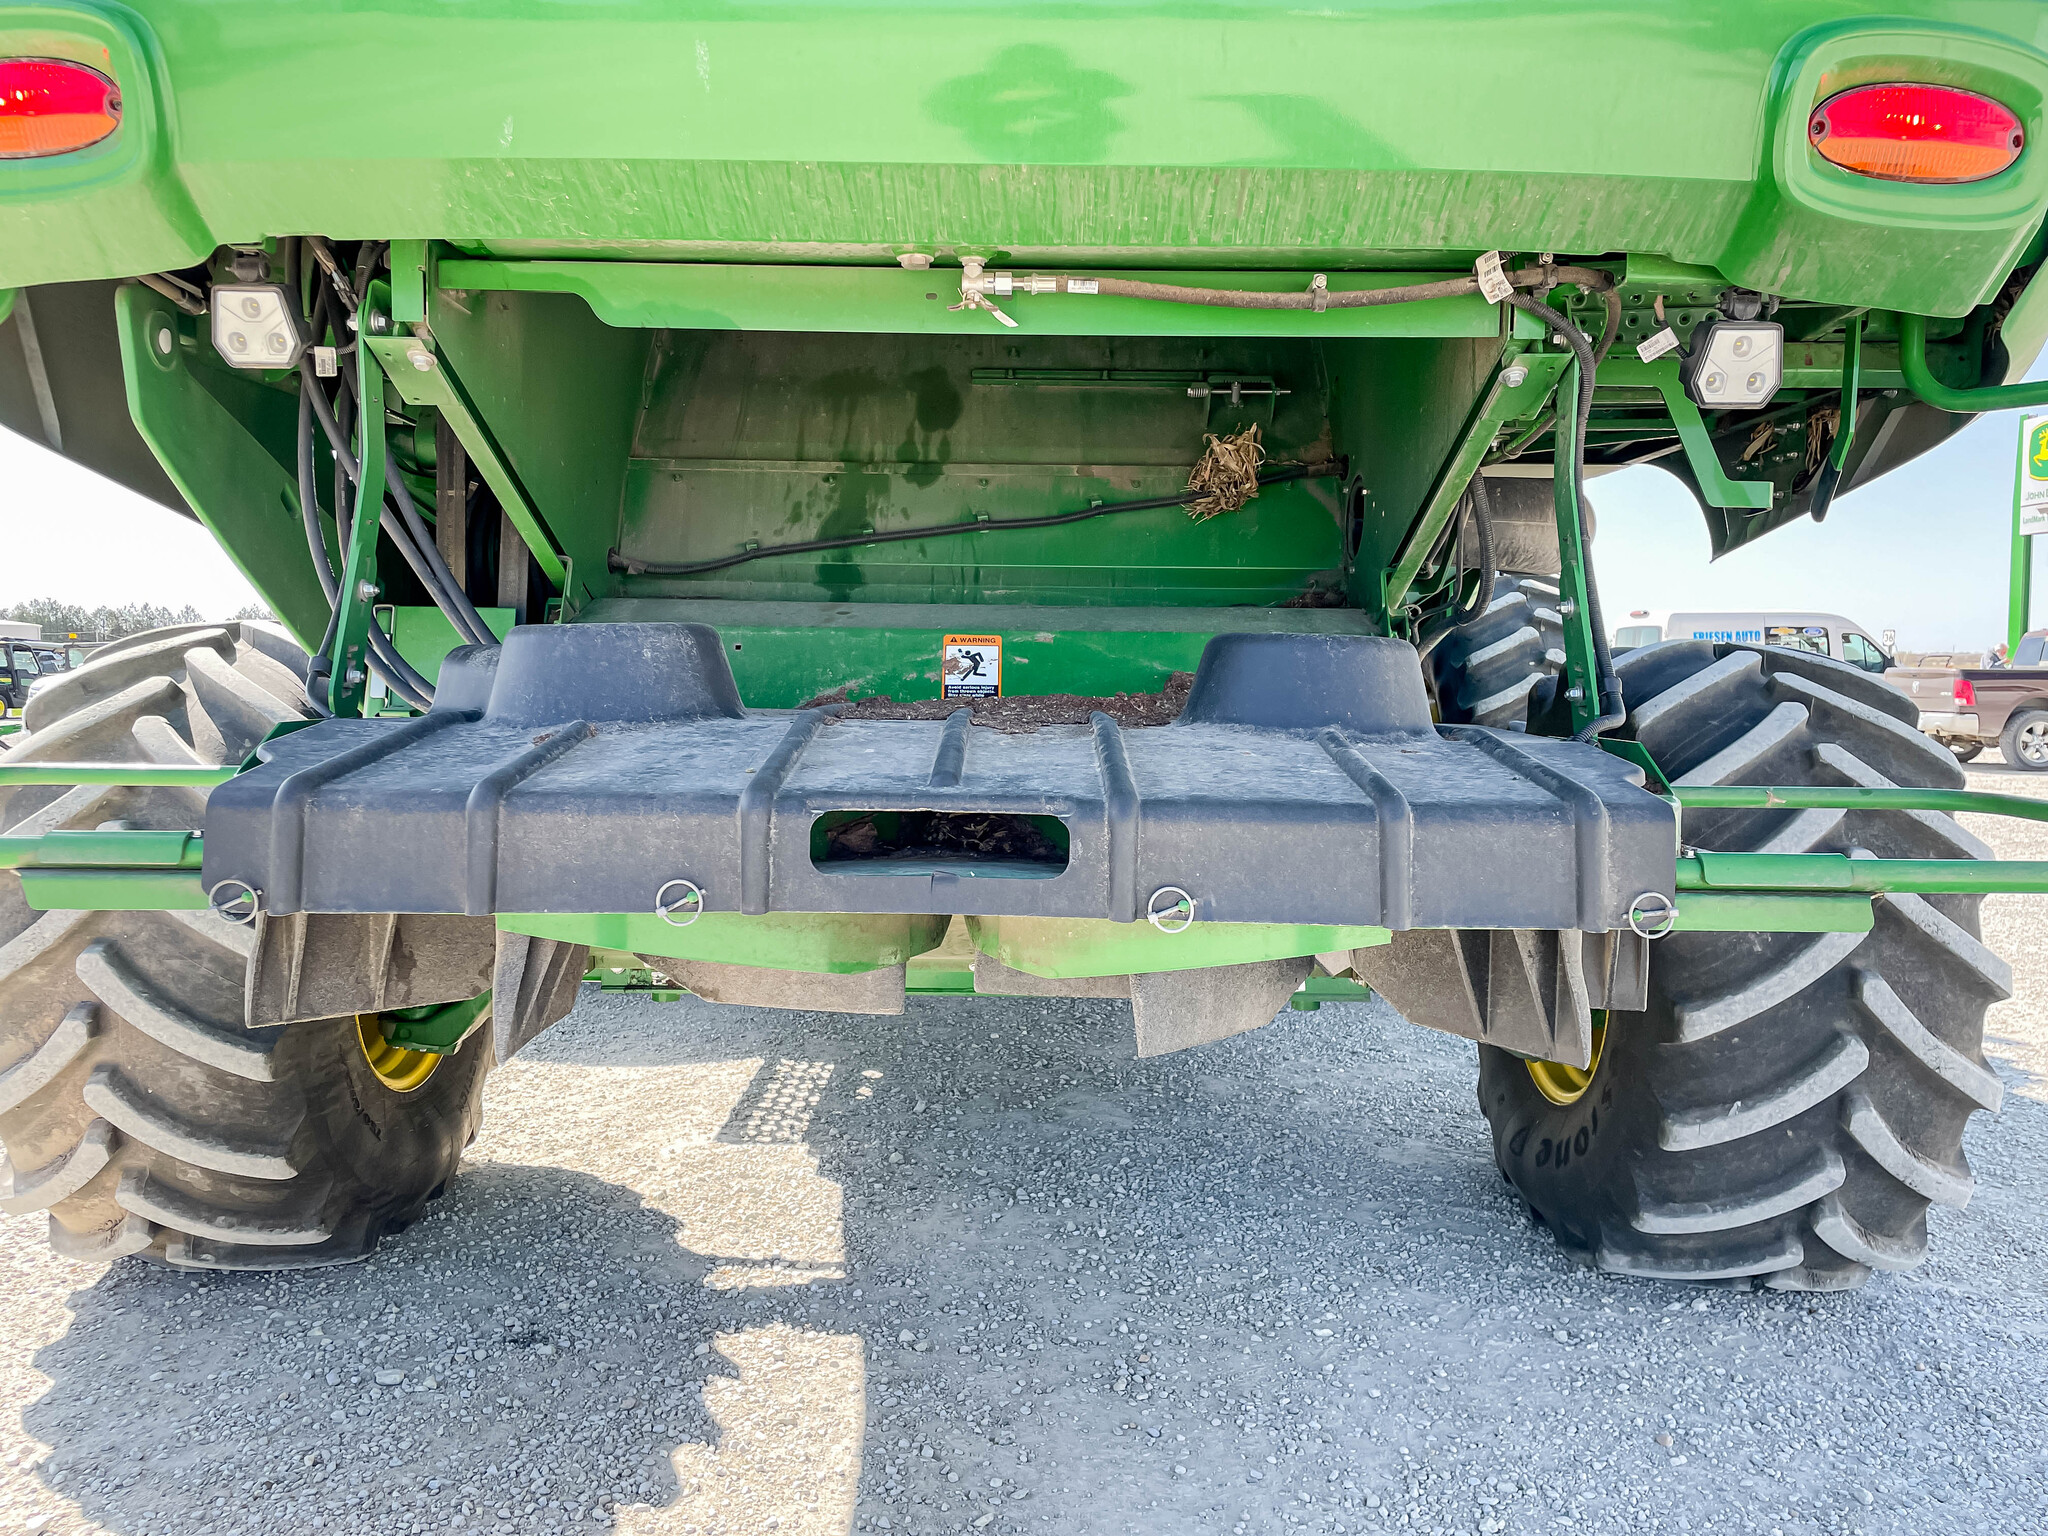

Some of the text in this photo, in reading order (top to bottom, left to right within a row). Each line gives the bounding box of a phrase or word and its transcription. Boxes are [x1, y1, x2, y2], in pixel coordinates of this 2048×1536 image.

[2025, 490, 2045, 500] JOHN
[2023, 515, 2045, 524] LandMark
[1693, 630, 1761, 642] FRIESEN AUTO
[1884, 633, 1894, 643] 36
